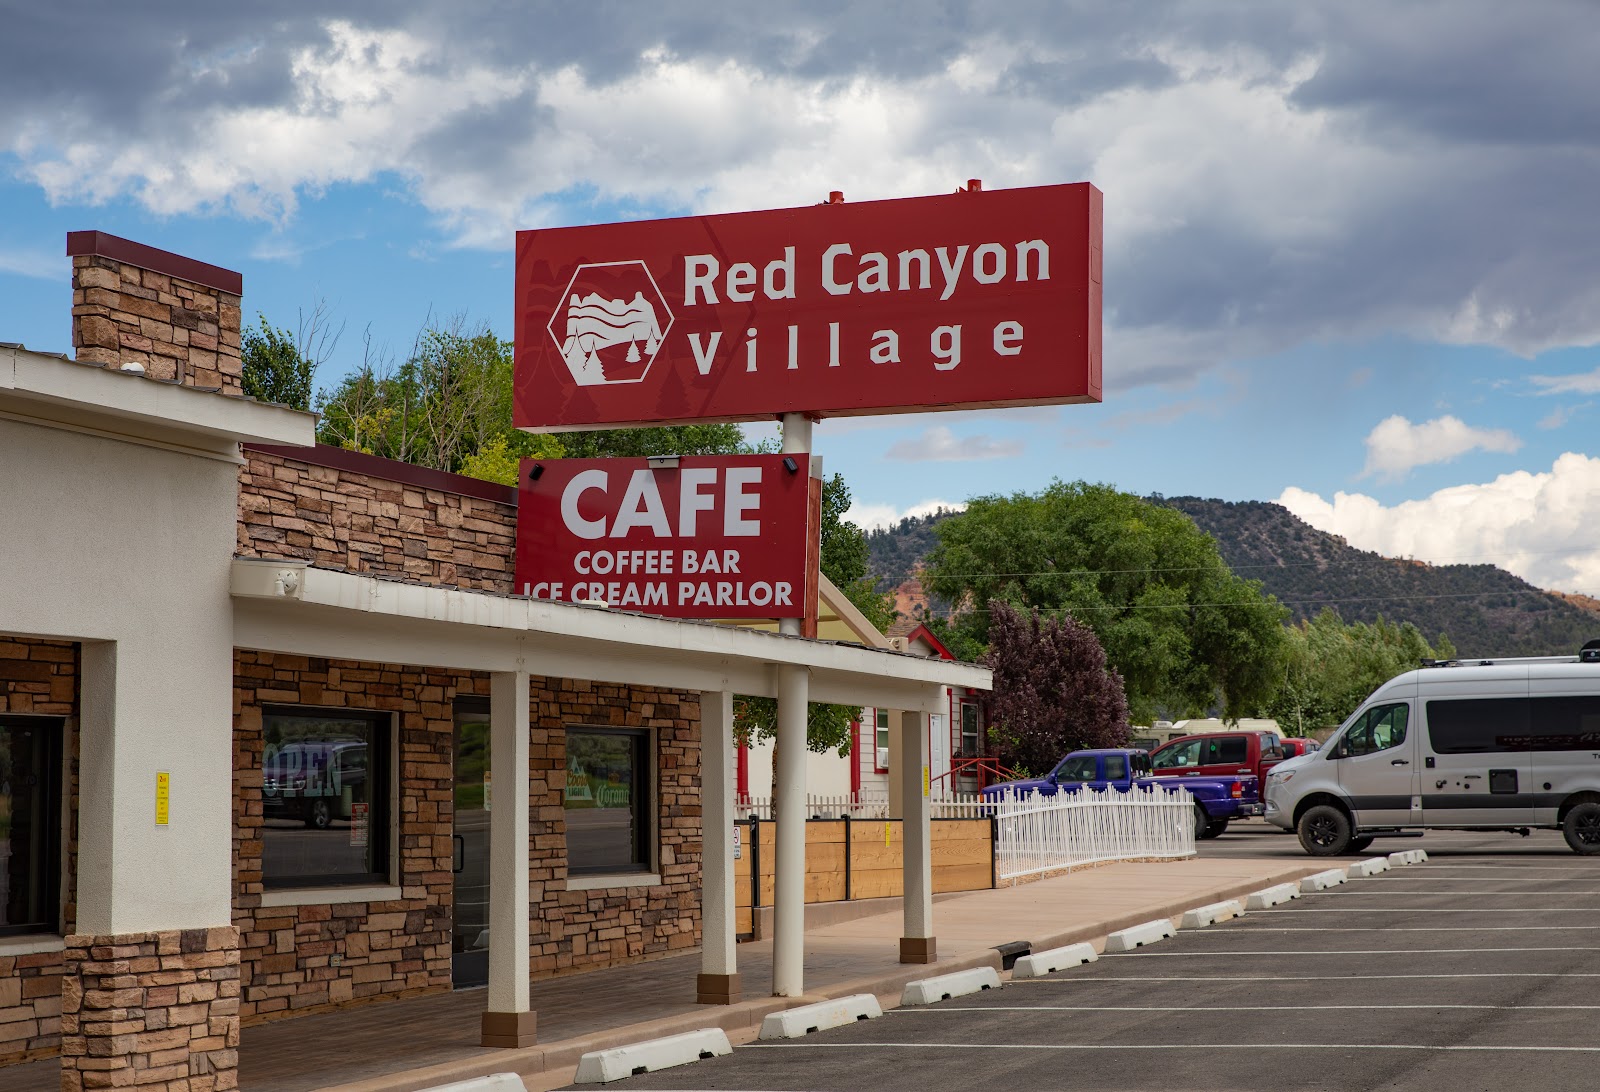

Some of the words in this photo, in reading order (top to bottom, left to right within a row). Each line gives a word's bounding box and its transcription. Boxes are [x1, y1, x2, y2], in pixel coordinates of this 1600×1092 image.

[683, 246, 796, 307] Red
[821, 239, 1051, 301] Canyon
[686, 321, 1024, 375] Village
[560, 466, 763, 540] CAFE
[573, 550, 675, 575] COFFEE
[682, 549, 741, 575] BAR
[570, 581, 669, 608] CREAM
[678, 581, 793, 608] PARLOR
[261, 742, 342, 798] OPEN
[596, 784, 630, 808] Corona
